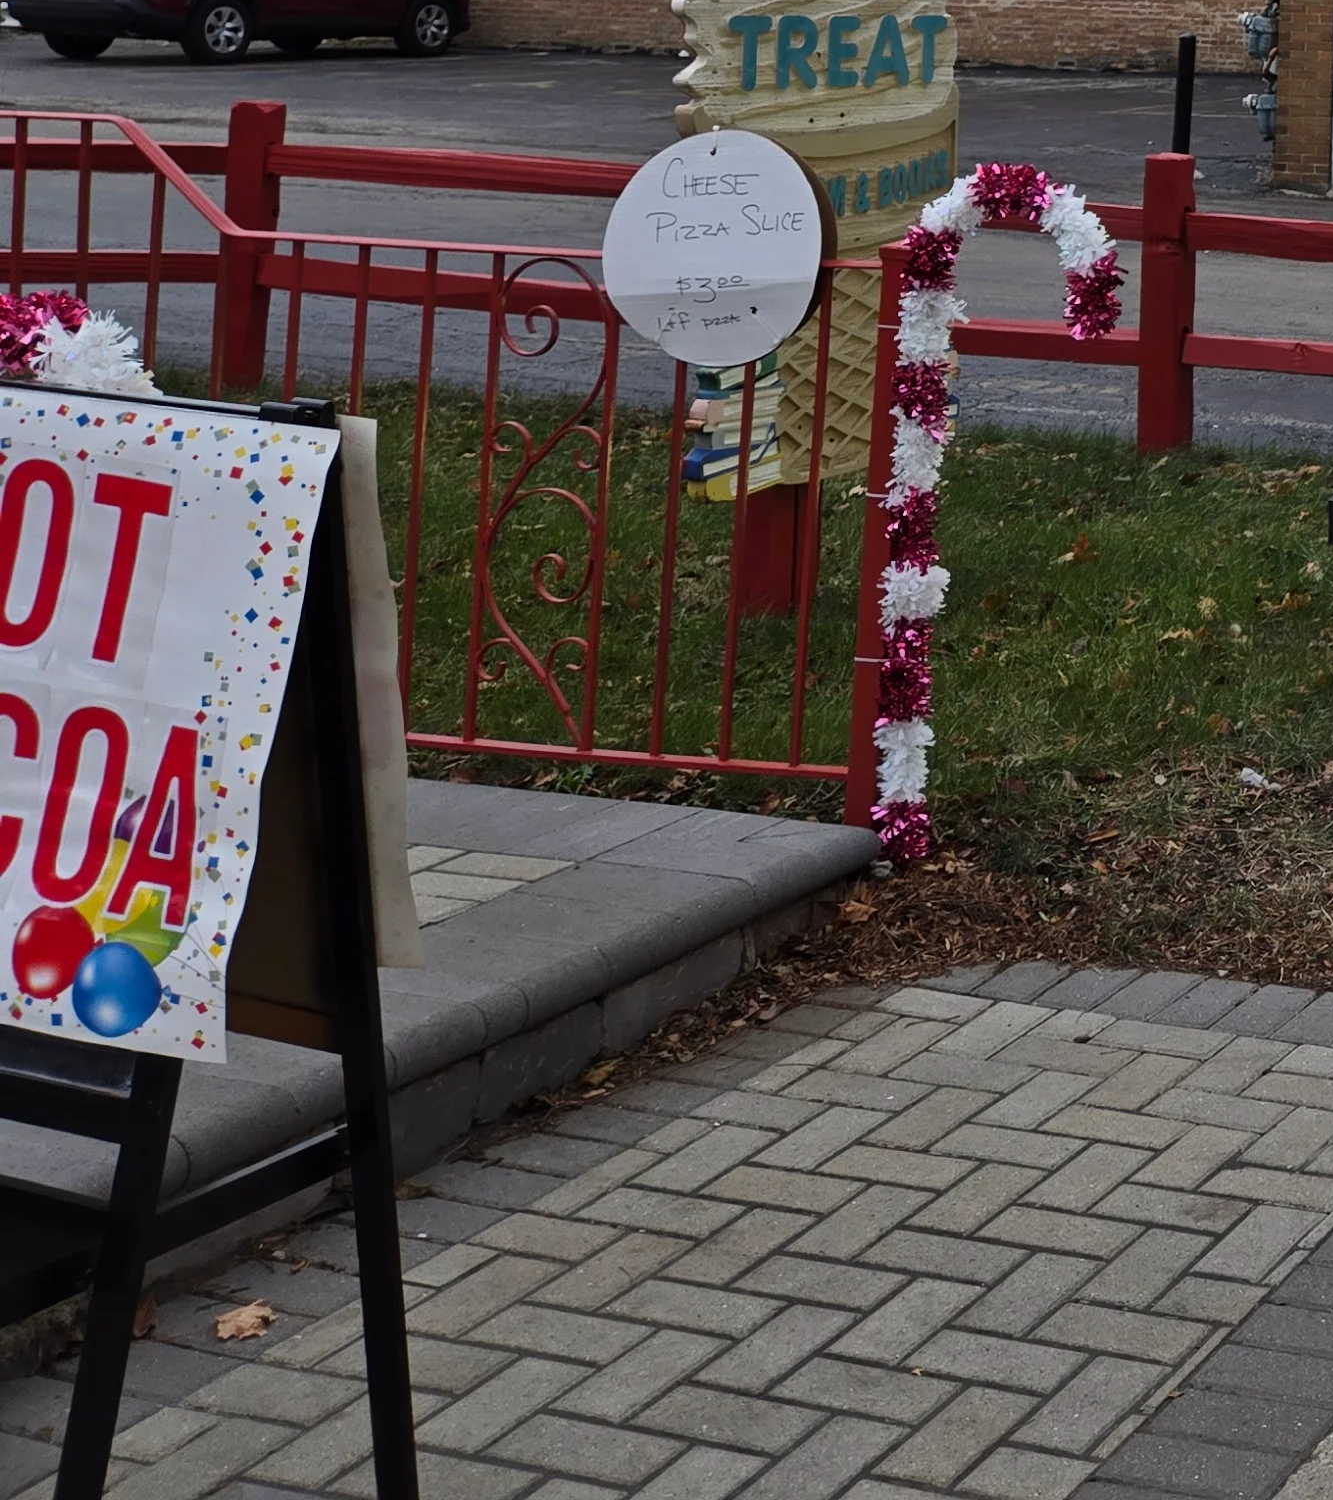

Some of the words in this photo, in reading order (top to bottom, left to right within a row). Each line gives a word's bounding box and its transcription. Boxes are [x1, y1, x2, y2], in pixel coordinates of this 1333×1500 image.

[728, 14, 948, 91] TREAT
[662, 157, 760, 198] CHEESE
[856, 171, 870, 213] &
[878, 147, 949, 208] BOOKS
[645, 211, 730, 243] PIZZA
[741, 204, 805, 236] SLICE
